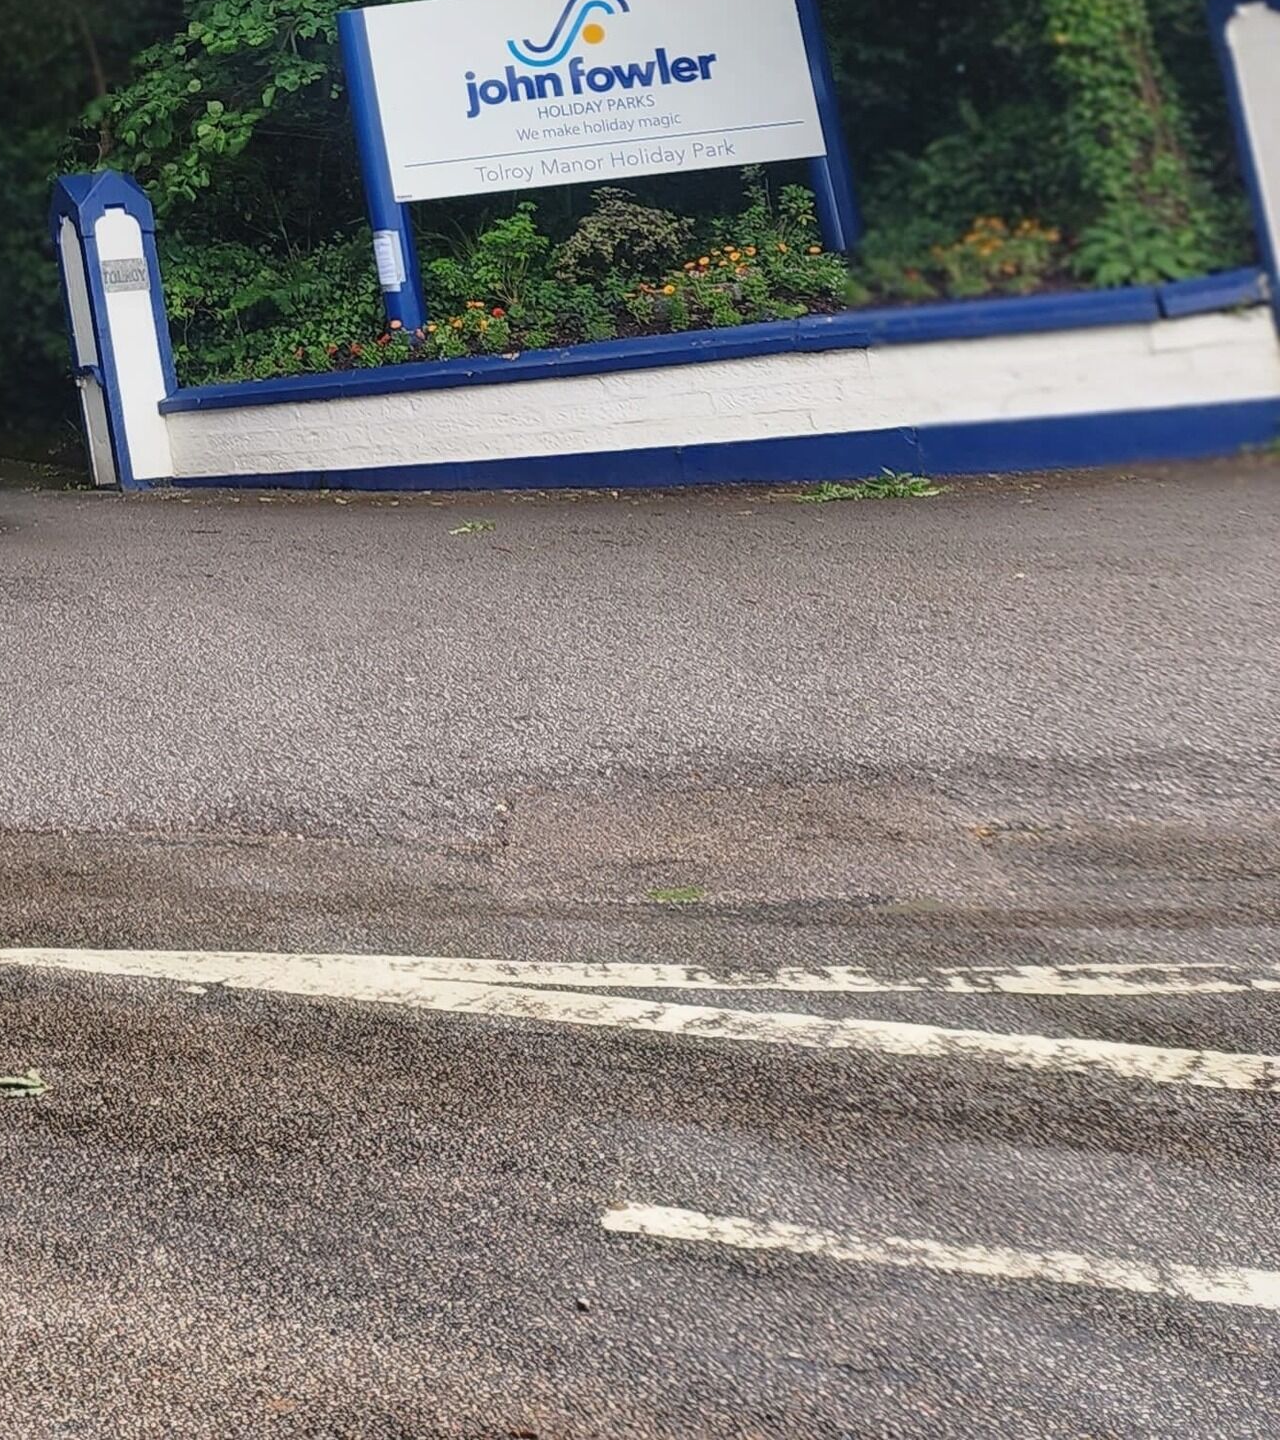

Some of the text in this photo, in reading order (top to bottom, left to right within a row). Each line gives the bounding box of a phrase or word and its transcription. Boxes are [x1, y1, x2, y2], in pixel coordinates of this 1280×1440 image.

[464, 47, 717, 118] john fowler
[537, 95, 655, 119] HOLIDAY PARKS
[516, 113, 682, 141] We make holiday magic
[475, 138, 736, 182] Tolroy Manor Holiday Park
